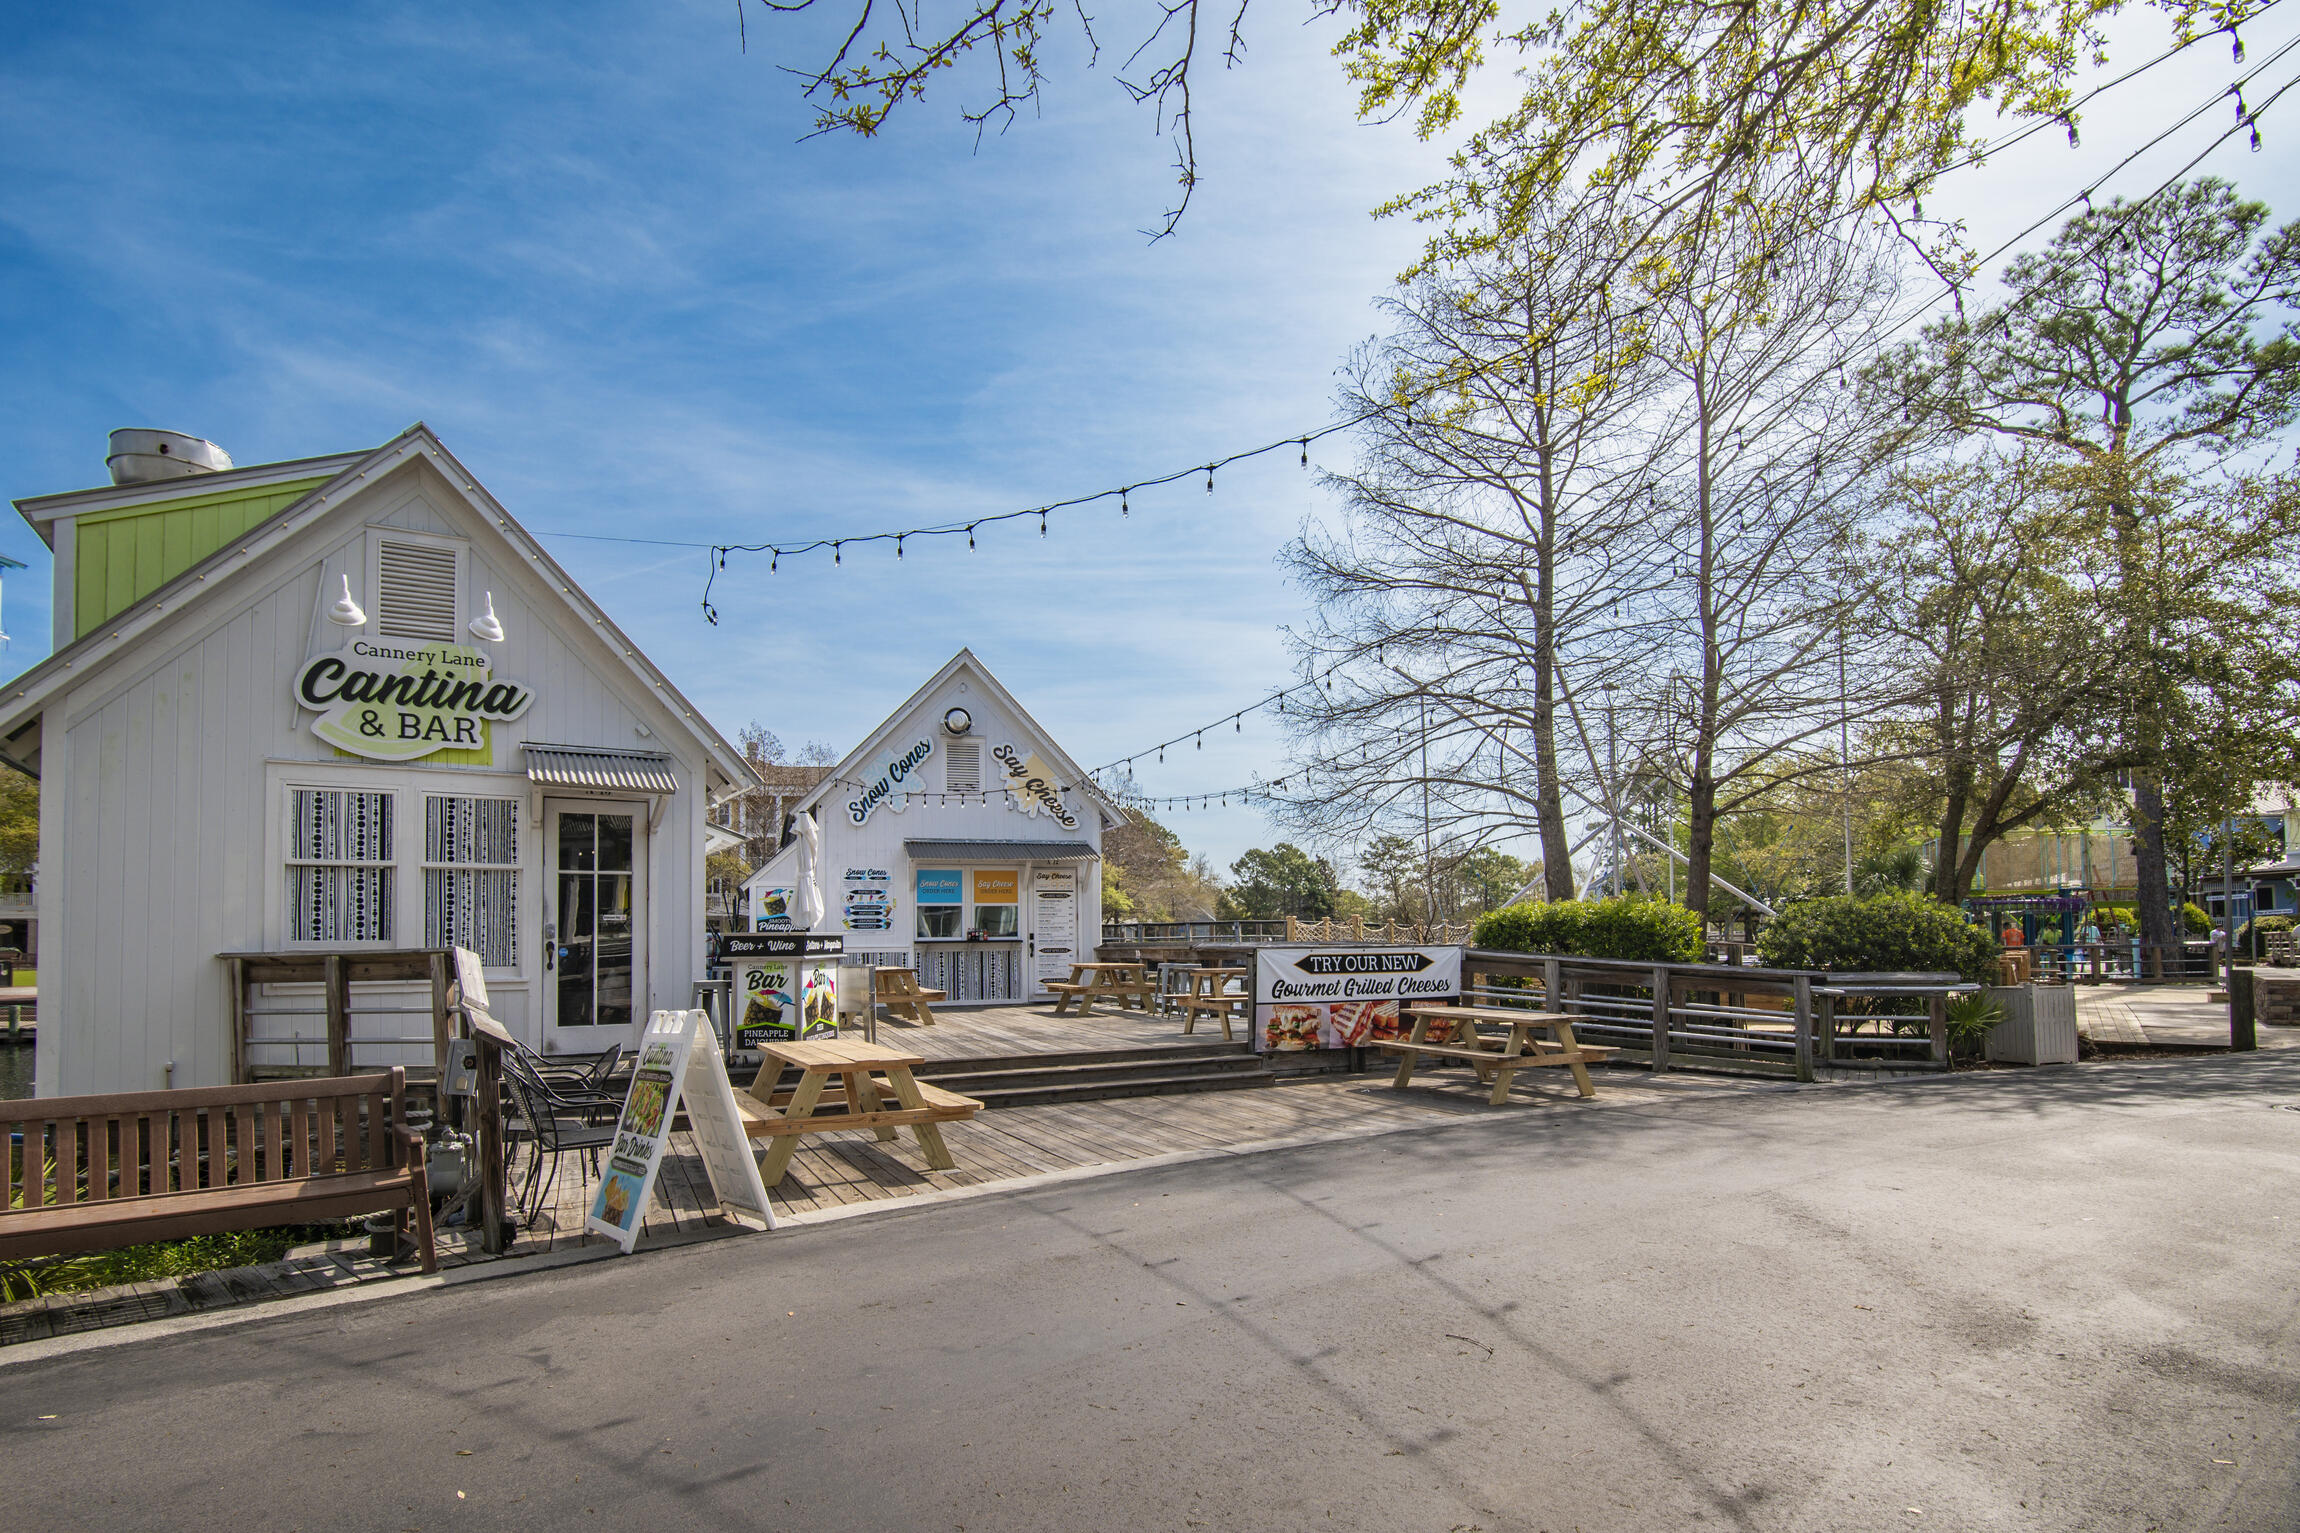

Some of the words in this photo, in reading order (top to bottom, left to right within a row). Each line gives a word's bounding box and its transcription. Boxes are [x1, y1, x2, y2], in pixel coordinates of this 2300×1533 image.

[353, 641, 436, 666] Cannery
[441, 650, 486, 668] Lane
[301, 657, 528, 715] Cantina
[359, 709, 386, 737] &
[398, 712, 478, 744] BAR
[848, 777, 890, 823] Snow
[889, 738, 931, 783] Cones
[993, 744, 1030, 778] Say
[1025, 778, 1077, 827] Cheese
[846, 867, 867, 876] Snow
[867, 868, 888, 877] Cones
[1036, 872, 1050, 881] Say
[920, 879, 939, 889] Snow
[939, 879, 959, 888] Cones
[977, 879, 991, 889] Say
[992, 880, 1014, 888] Cheese
[729, 940, 755, 952] Beer
[767, 940, 796, 951] Wine
[1310, 955, 1342, 972] TRY
[1345, 955, 1378, 972] OUR
[1381, 955, 1418, 971] NEW
[745, 970, 789, 991] Bar
[813, 968, 827, 988] Bar
[1271, 979, 1342, 999] Gourmet
[1344, 977, 1396, 997] Grilled
[1397, 976, 1452, 995] Cheeses
[744, 1030, 789, 1038] PINEAPPLE
[643, 1044, 674, 1066] Cantina
[615, 1132, 629, 1153] Bar
[627, 1136, 655, 1160] Drinks
